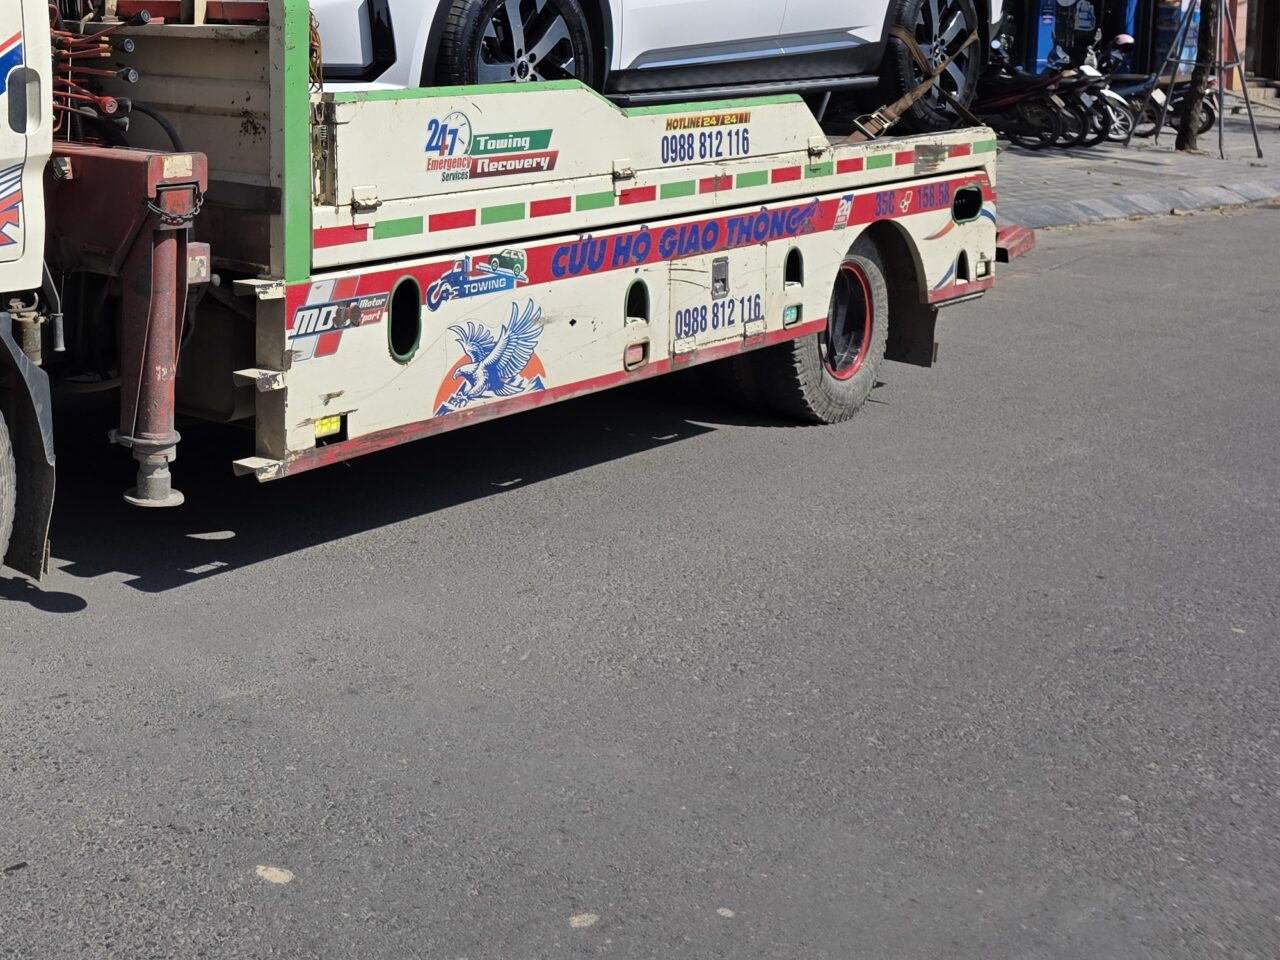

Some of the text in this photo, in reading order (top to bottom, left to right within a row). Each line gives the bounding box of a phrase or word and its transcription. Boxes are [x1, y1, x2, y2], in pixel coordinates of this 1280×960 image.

[665, 116, 701, 132] HOTLINE
[477, 134, 531, 151] Towing
[661, 127, 750, 164] 0988 812 116
[426, 155, 472, 172] Emergency
[476, 156, 550, 173] Recovery
[441, 170, 469, 182] Services
[875, 182, 951, 217] 35C 158.58
[551, 205, 807, 279] CỨU HỘ GIAO THÔNG
[463, 277, 507, 295] TOWING
[359, 296, 386, 309] Motor
[359, 311, 381, 324] port
[674, 293, 762, 338] 0988 812 116
